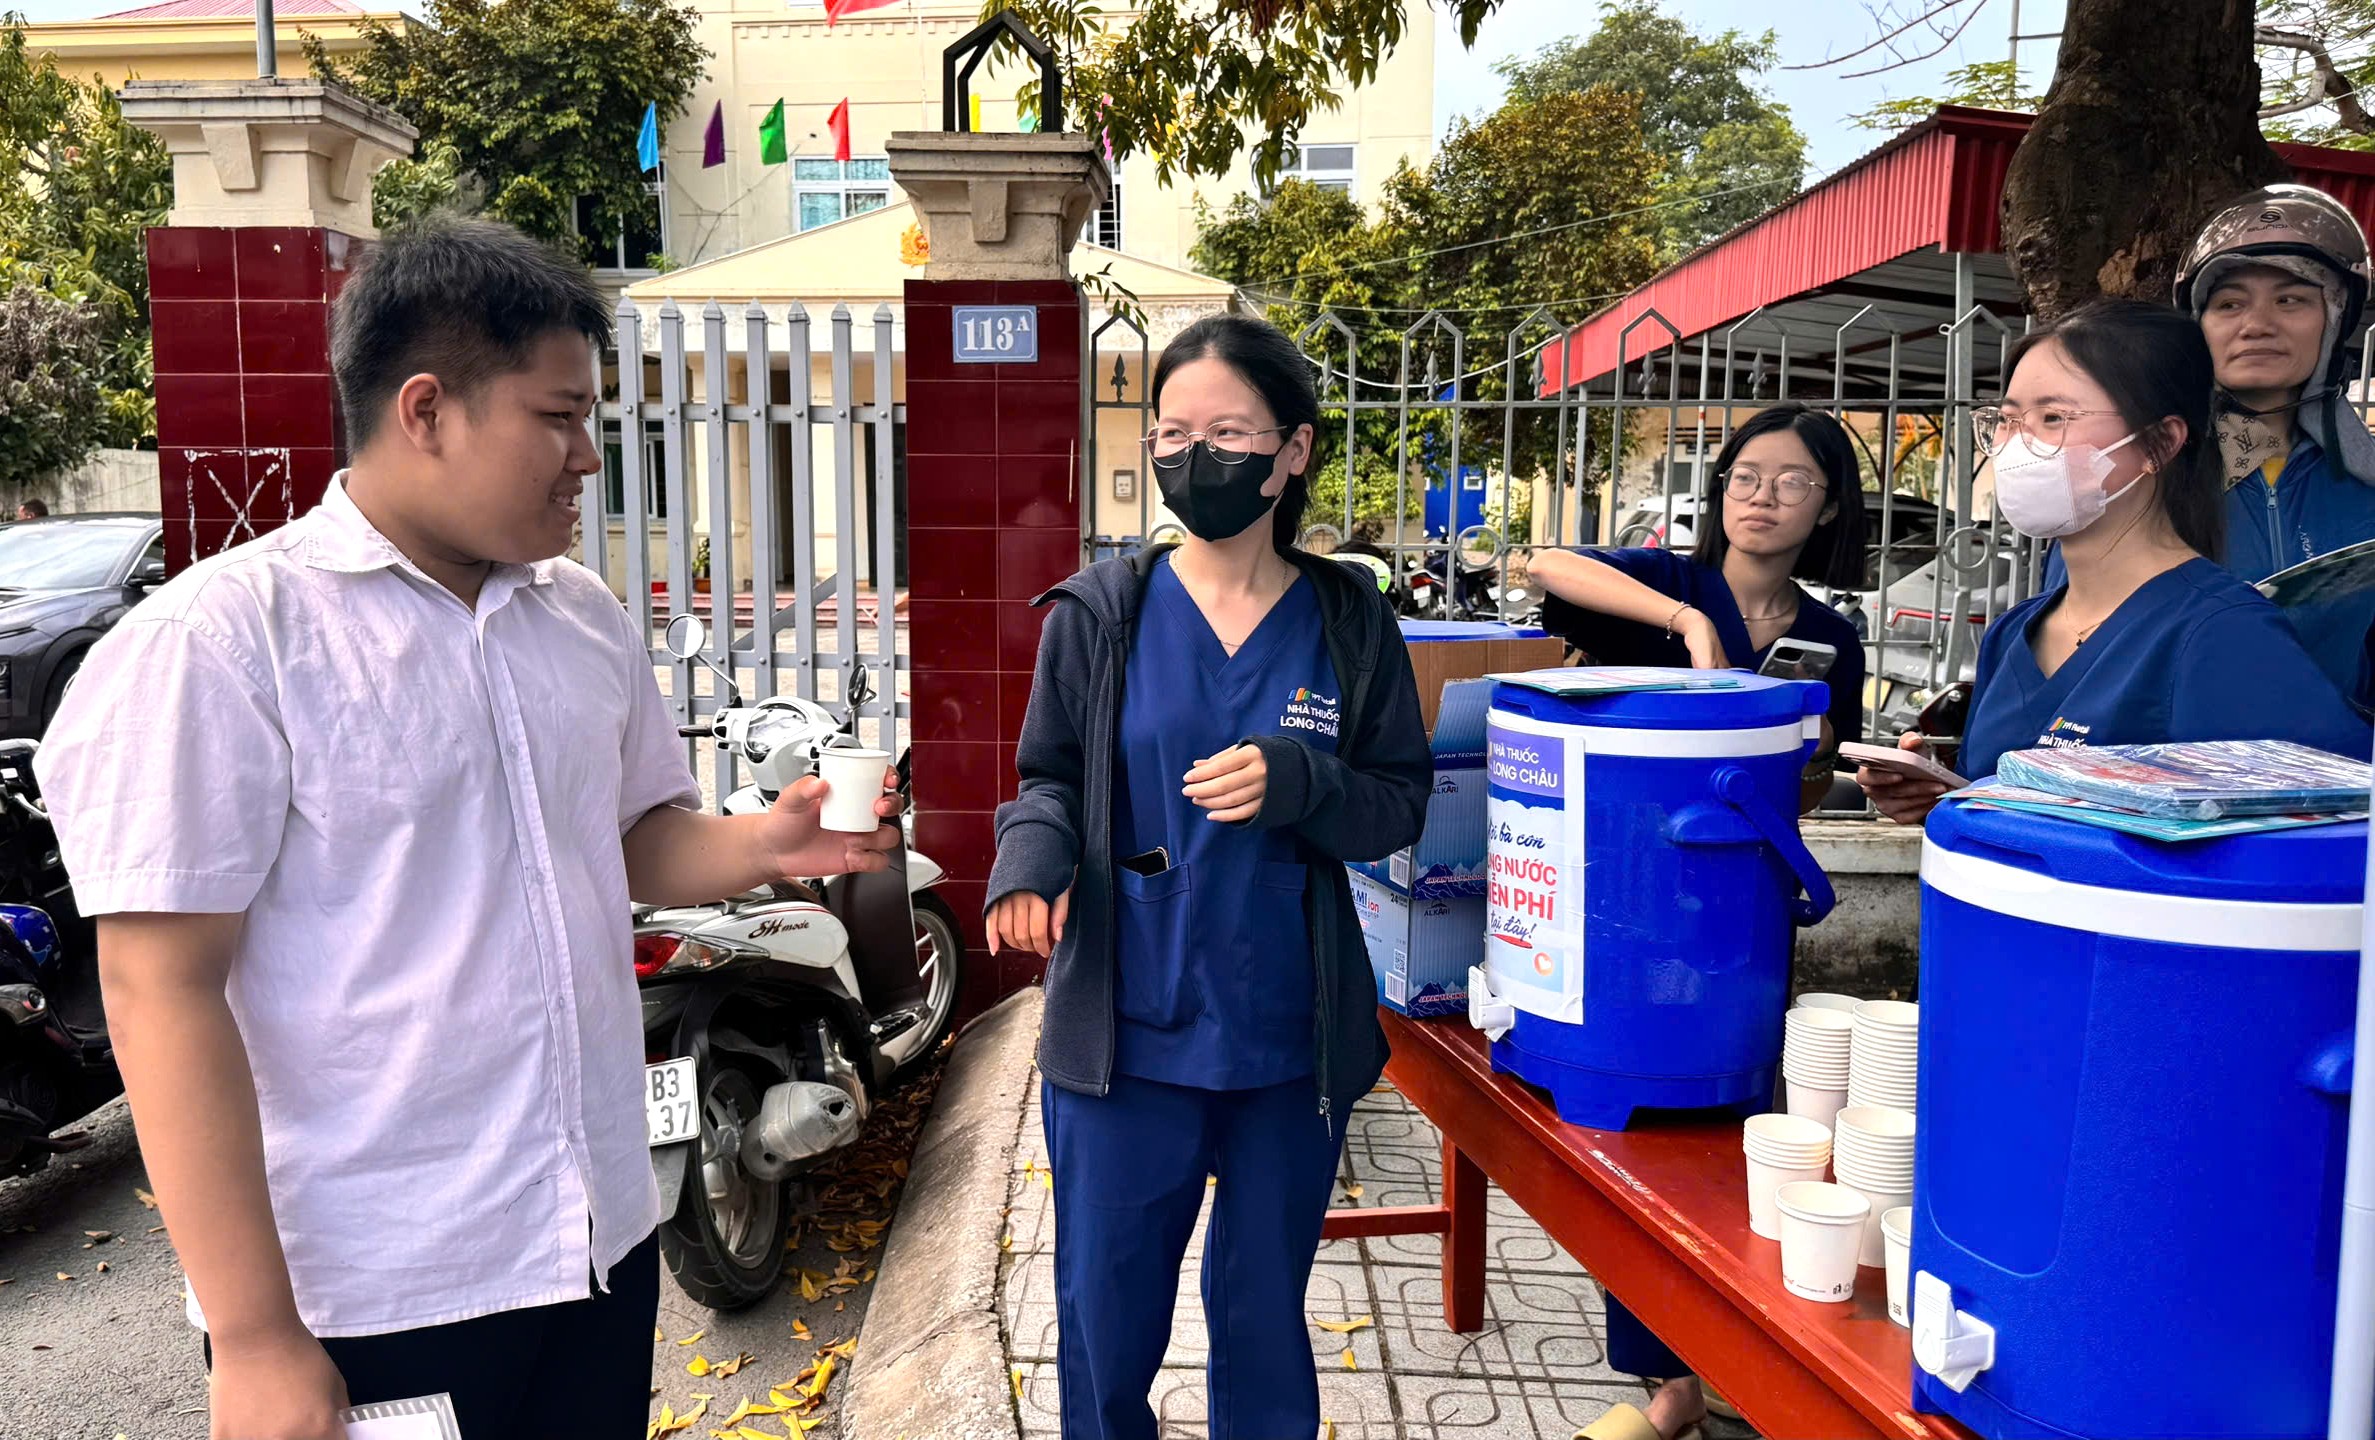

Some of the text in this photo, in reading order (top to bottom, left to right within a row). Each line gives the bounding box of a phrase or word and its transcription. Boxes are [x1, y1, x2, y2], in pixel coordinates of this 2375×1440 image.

[1280, 715, 1315, 730] LONG
[1287, 703, 1340, 722] NHÀ THUỐC
[1506, 746, 1539, 764] THUỐC
[1493, 760, 1558, 788] LONG CHÂU
[1499, 821, 1513, 843] bà
[1504, 856, 1557, 886] NƯỚC
[1488, 872, 1557, 921] IỄN PHÍ
[651, 1067, 680, 1102] B3
